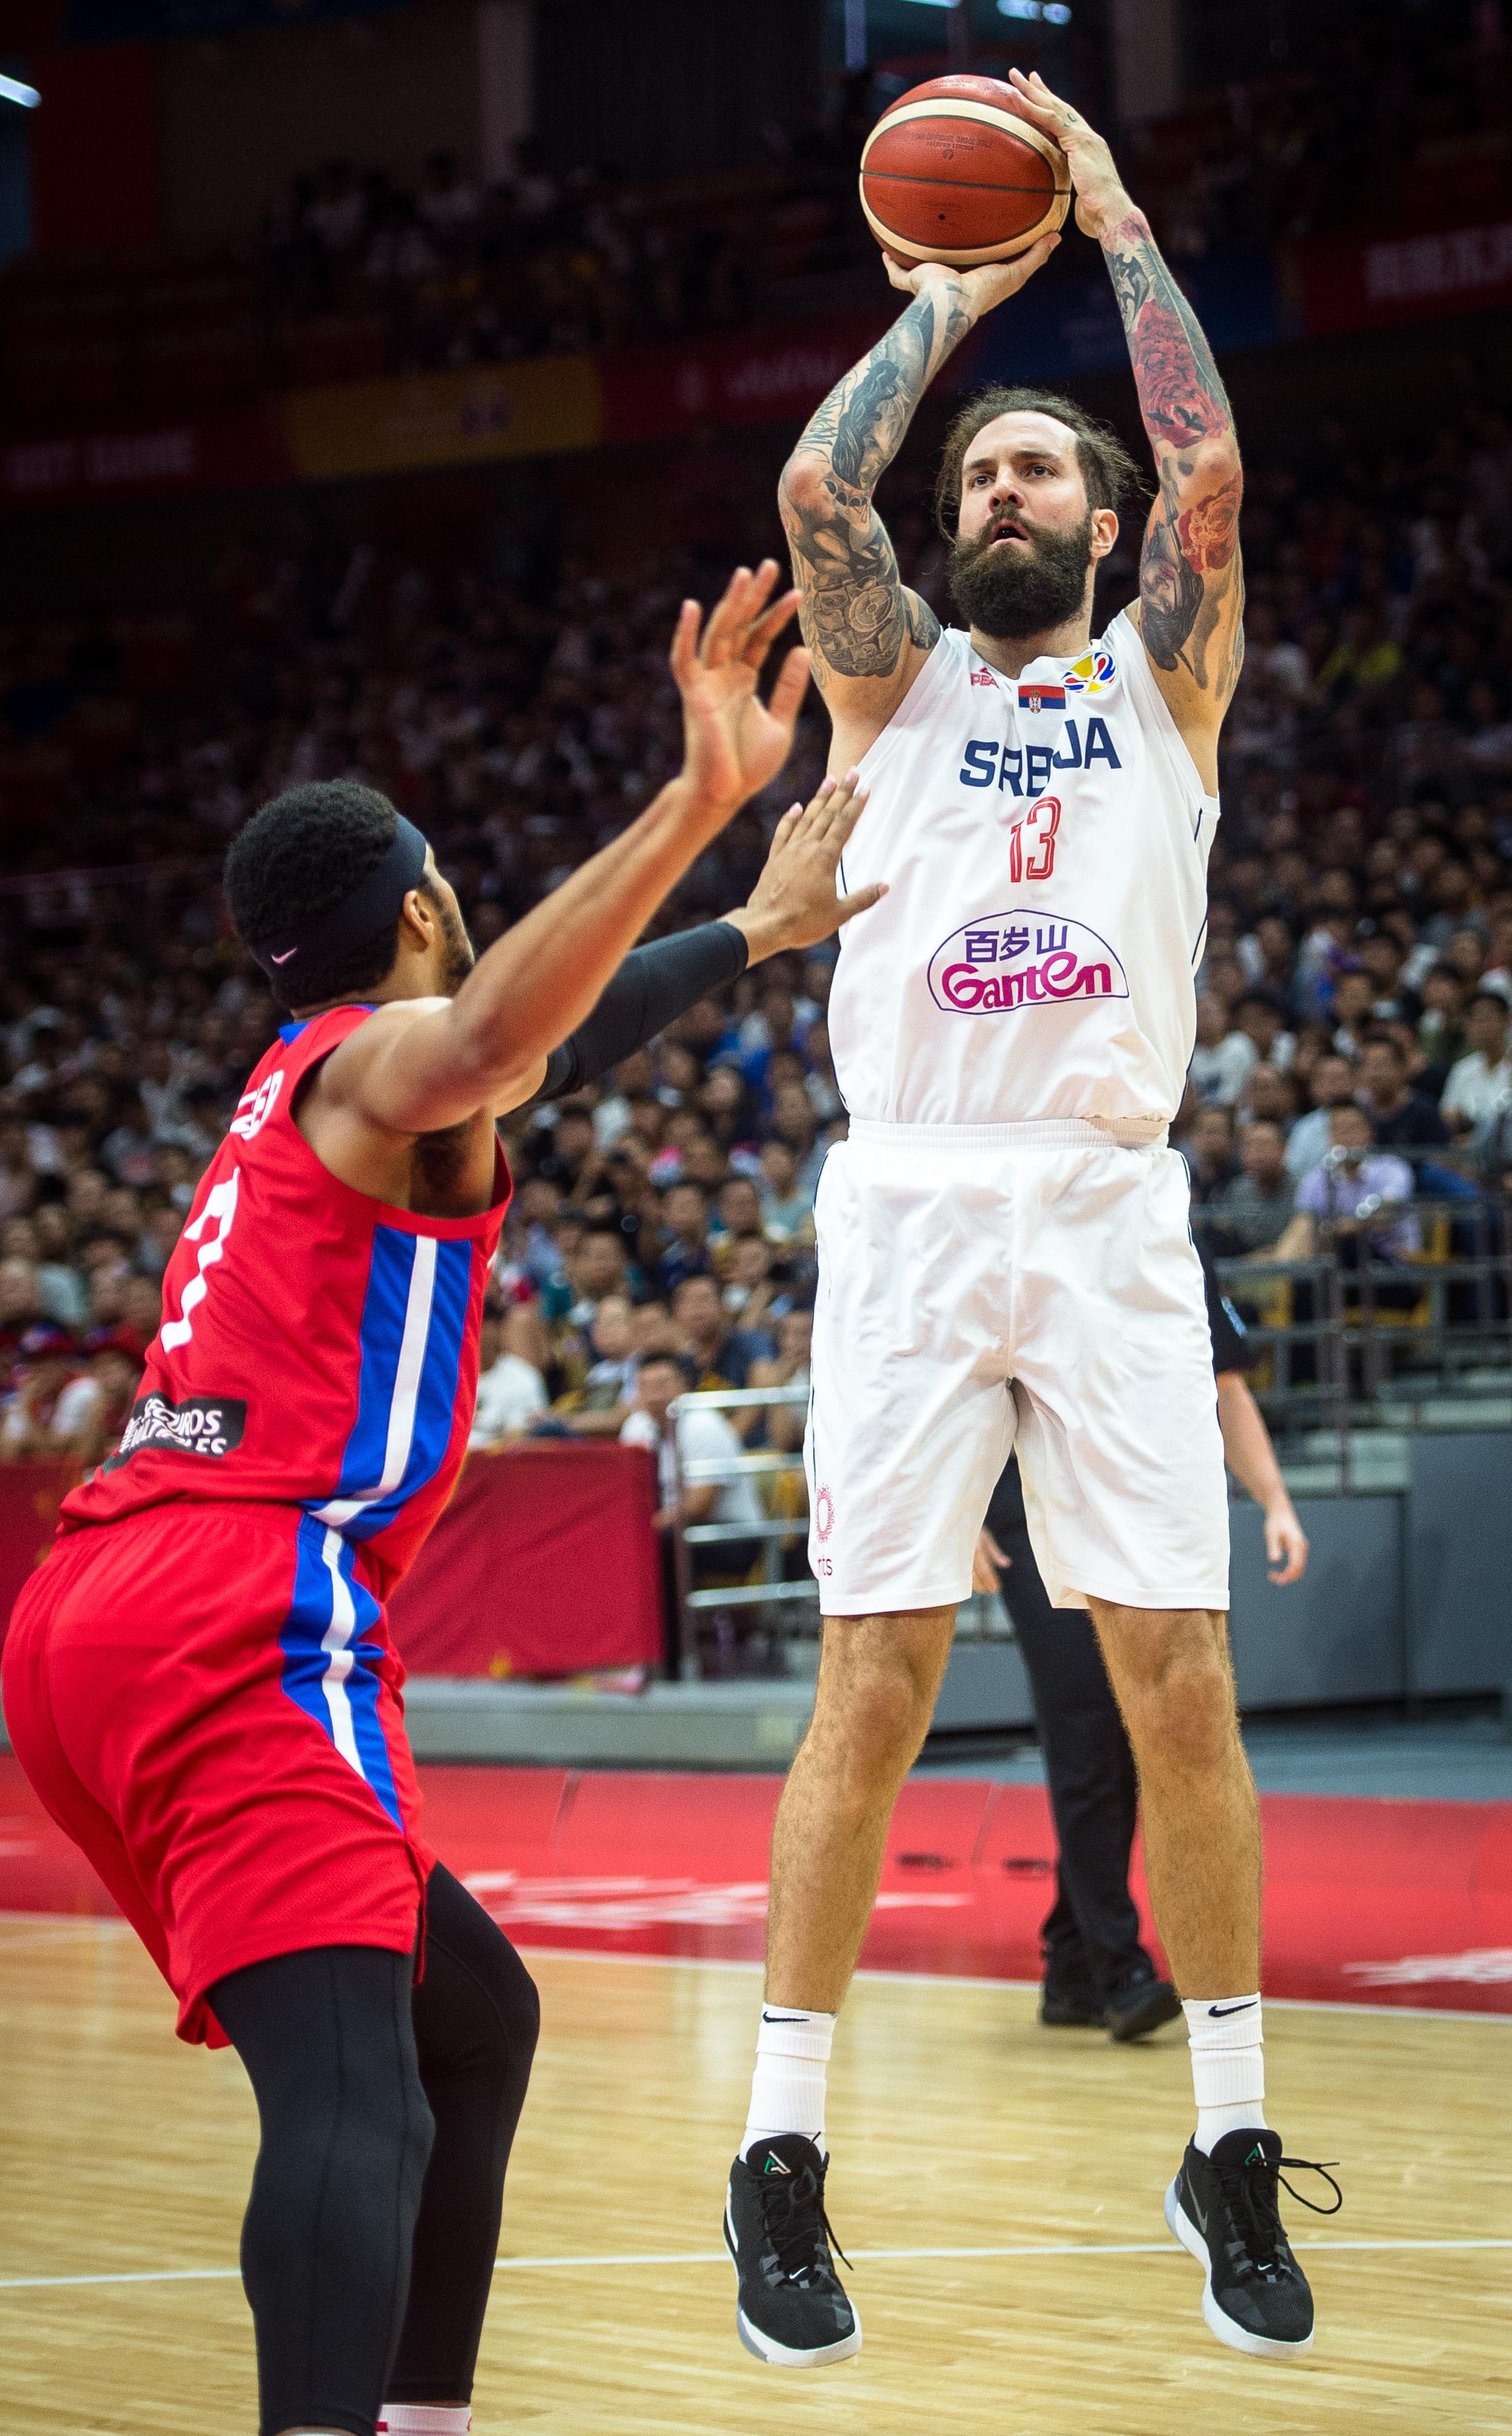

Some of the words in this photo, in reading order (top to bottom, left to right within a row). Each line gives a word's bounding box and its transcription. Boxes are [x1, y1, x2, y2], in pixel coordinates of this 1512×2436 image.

[970, 672, 999, 689] PEA
[960, 718, 1122, 798] SRBJA
[1010, 796, 1062, 883] 13
[964, 925, 1069, 963] 百岁山
[161, 1166, 241, 1353] 7
